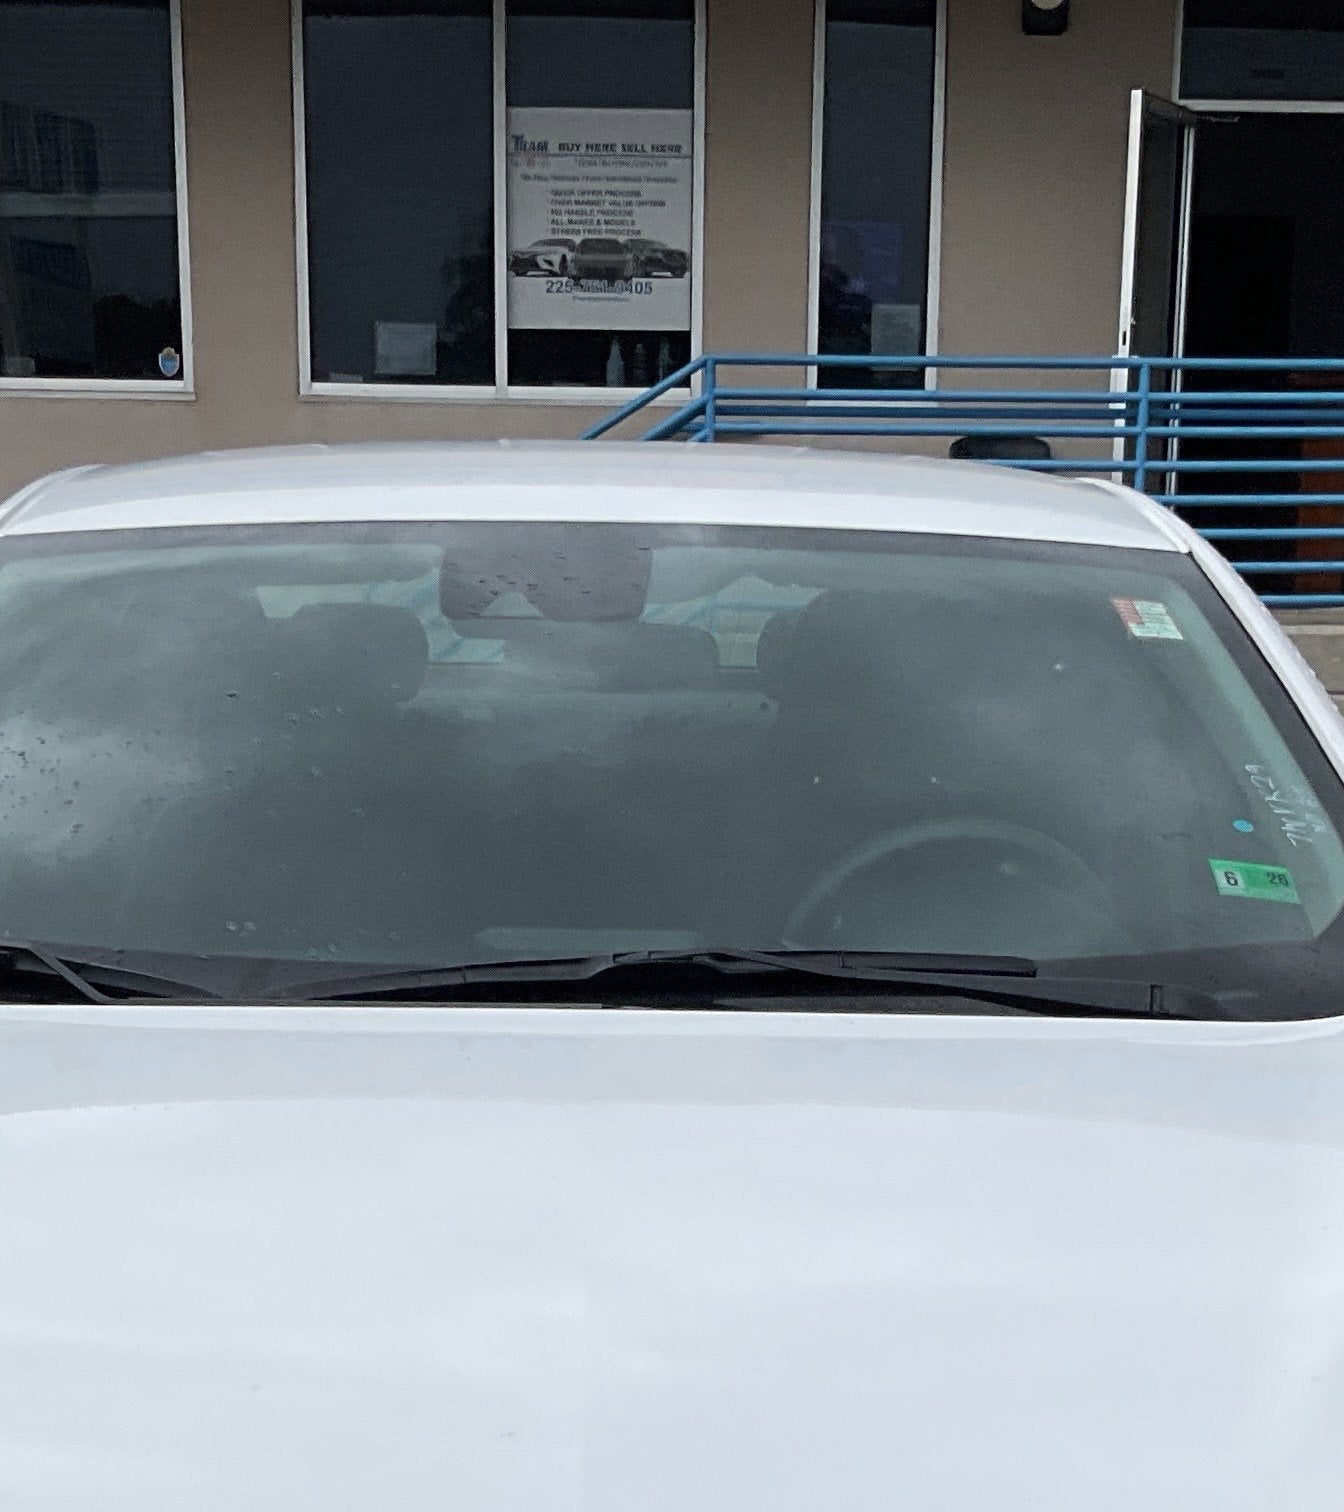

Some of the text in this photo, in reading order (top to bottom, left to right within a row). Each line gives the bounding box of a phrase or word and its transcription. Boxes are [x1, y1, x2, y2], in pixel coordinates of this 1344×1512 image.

[558, 142, 582, 152] BUY
[585, 142, 617, 153] HERE
[621, 143, 647, 154] SELL
[1224, 870, 1239, 886] 6
